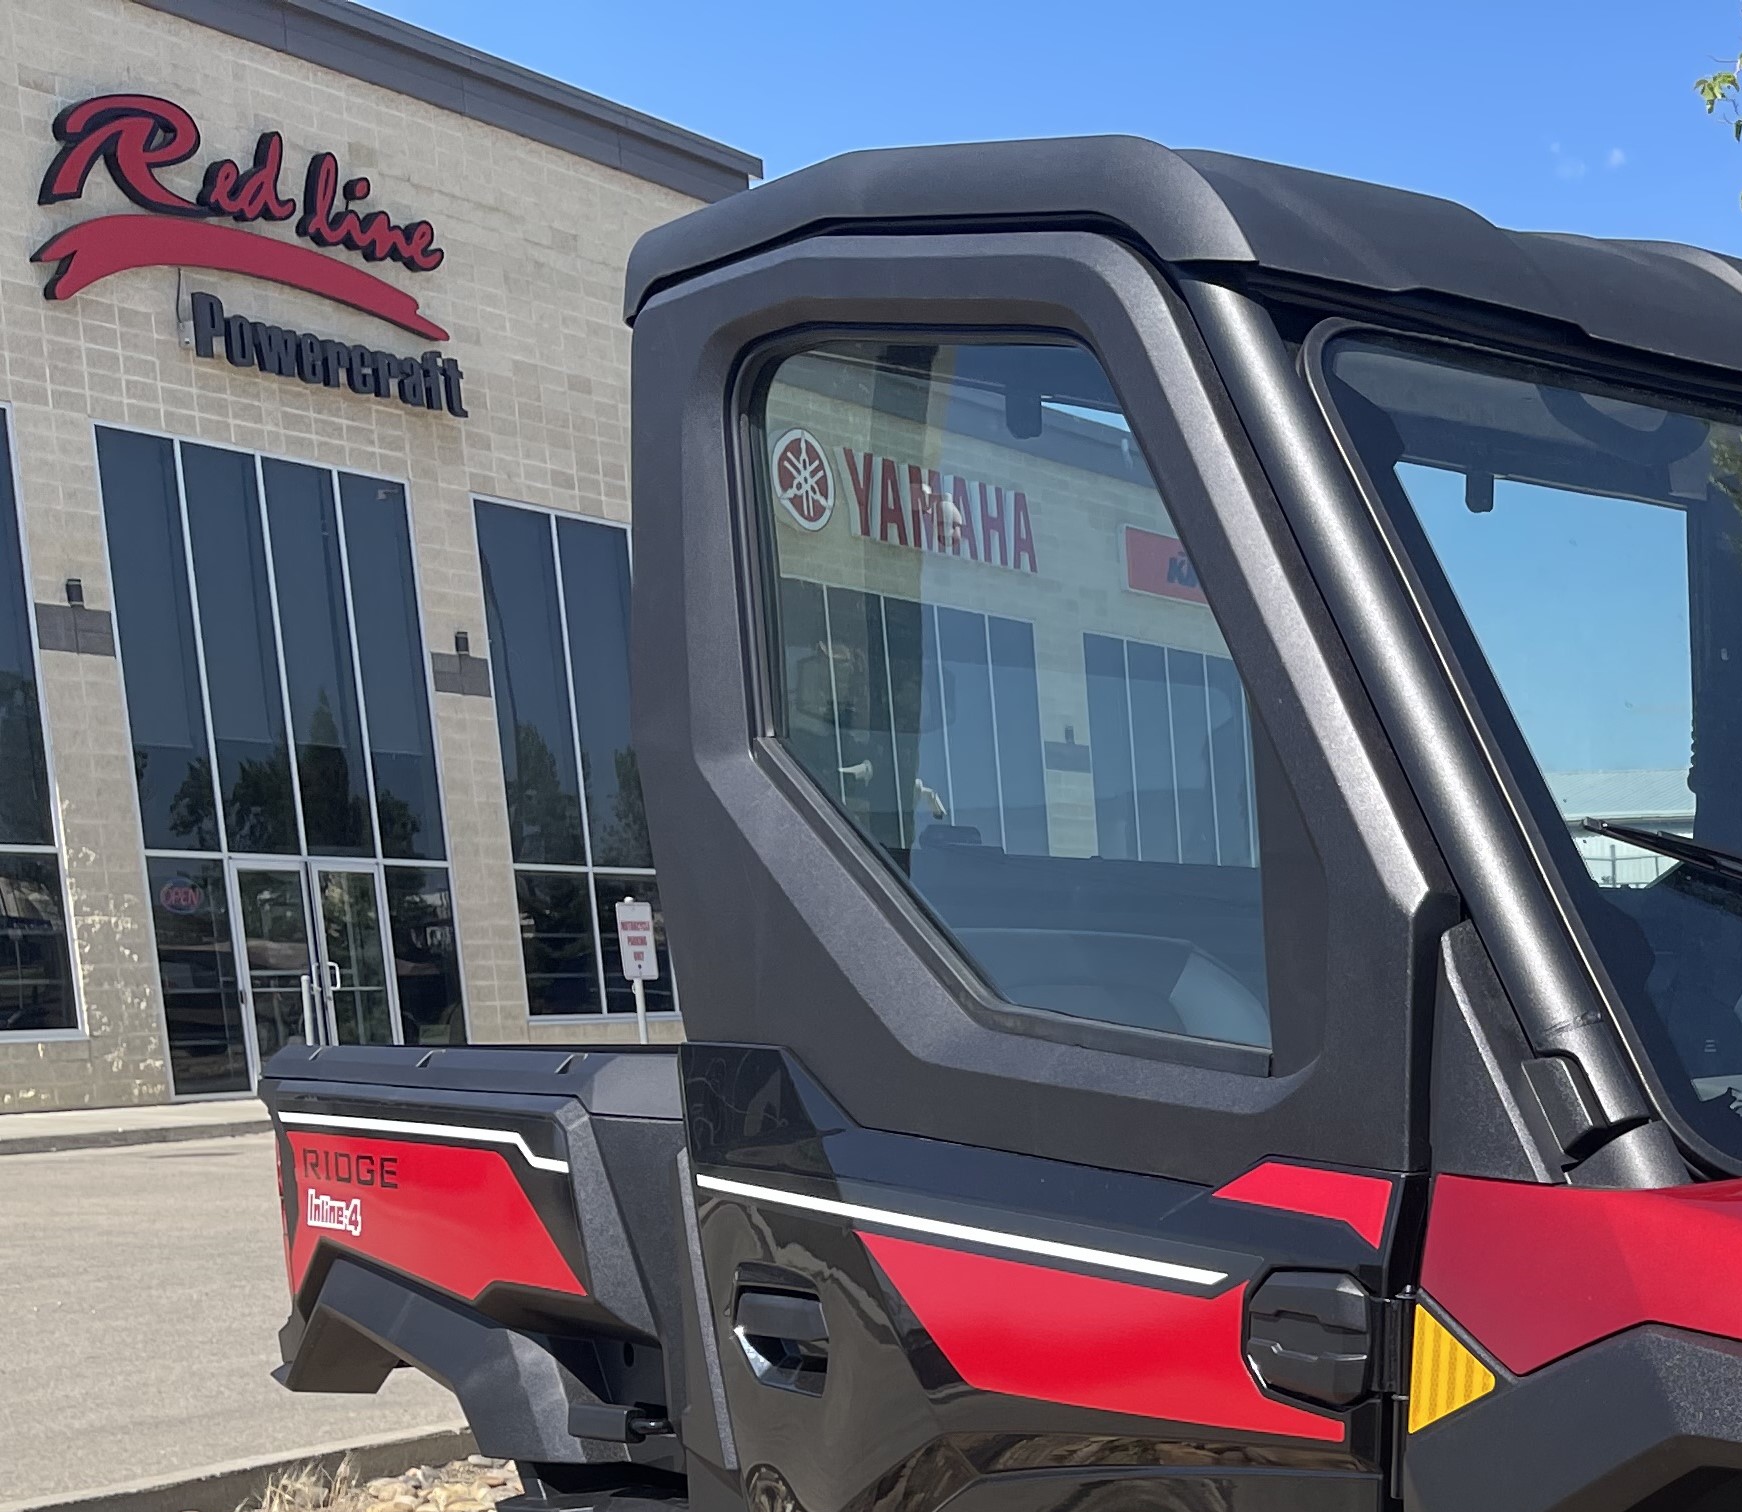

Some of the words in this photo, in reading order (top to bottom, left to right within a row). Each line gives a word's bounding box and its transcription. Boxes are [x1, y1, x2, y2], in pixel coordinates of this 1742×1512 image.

[38, 94, 296, 222] Red
[191, 291, 468, 418] Powercraft
[836, 446, 1038, 574] YAMAHA
[303, 1148, 398, 1190] RIDGE
